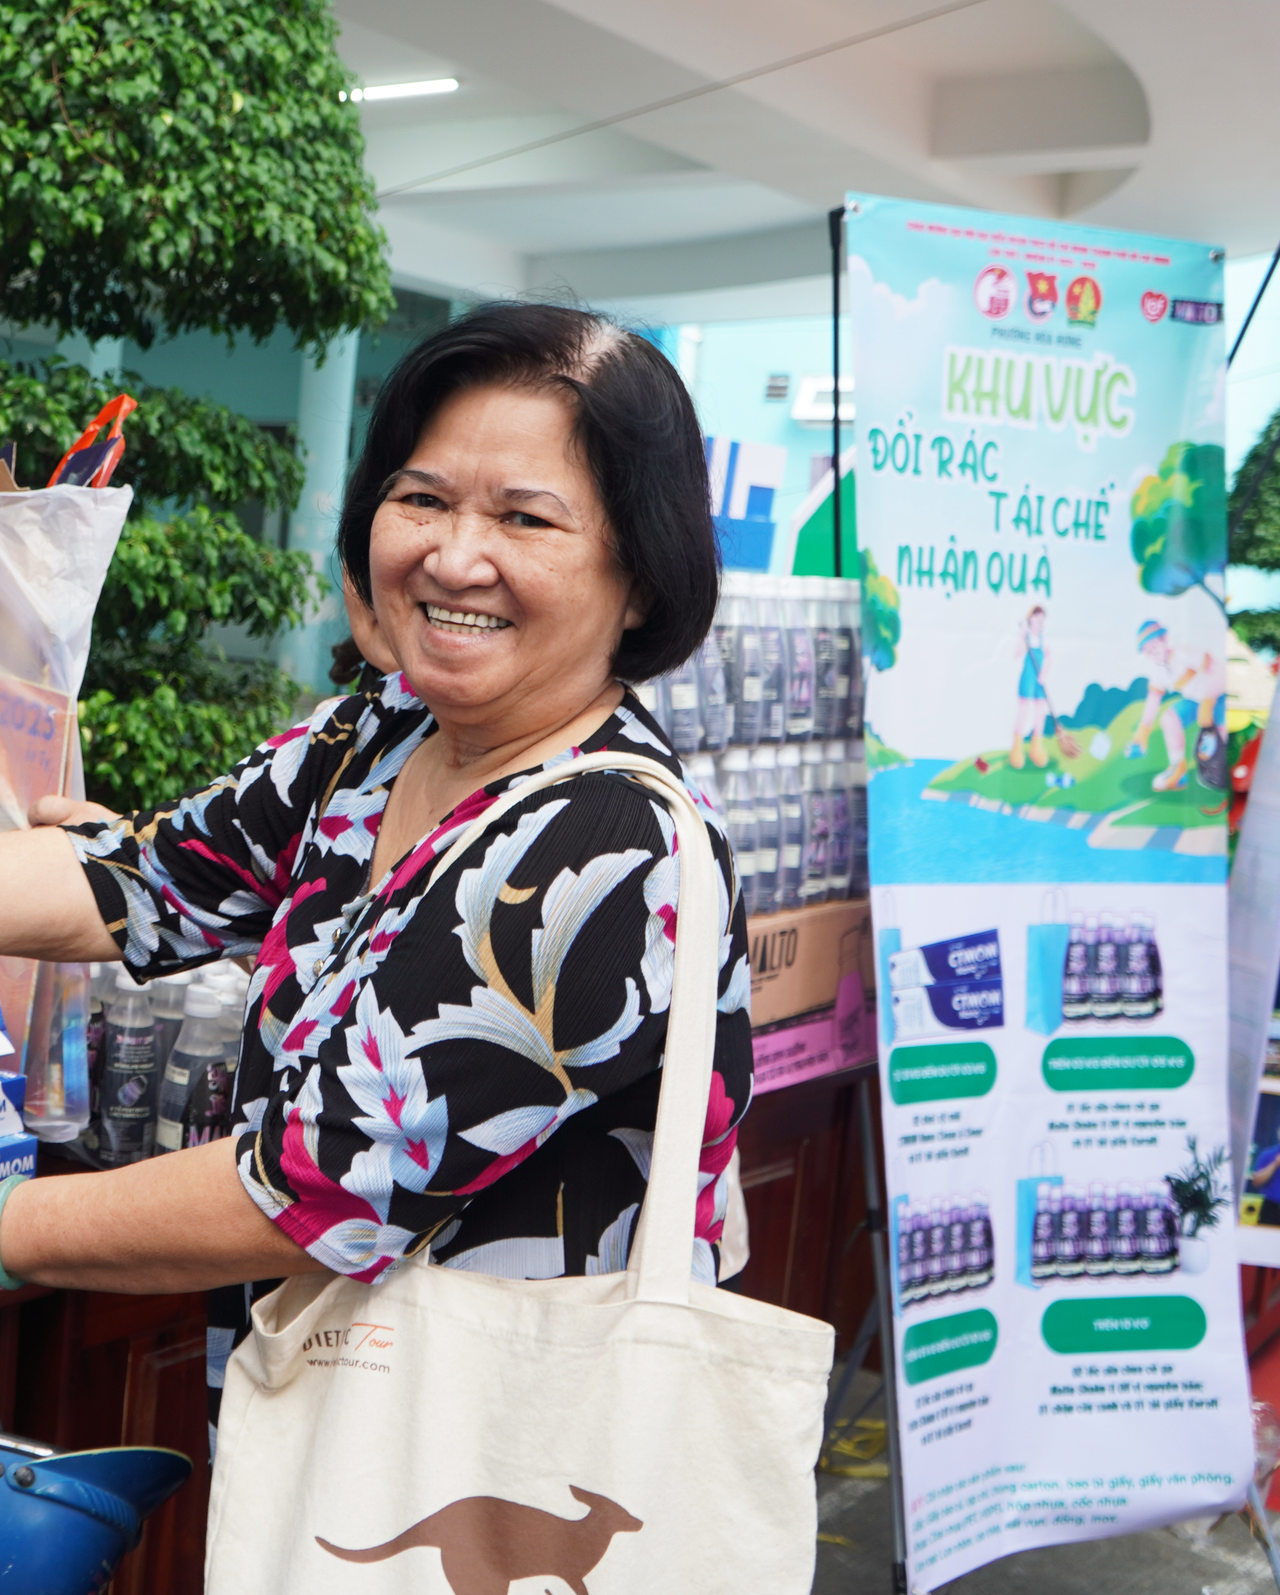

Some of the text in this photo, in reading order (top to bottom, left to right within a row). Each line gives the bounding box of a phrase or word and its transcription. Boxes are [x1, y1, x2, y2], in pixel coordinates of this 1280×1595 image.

[946, 352, 1131, 443] KHU VỰC
[931, 428, 998, 483] RÁC
[988, 484, 1043, 537] TÁI
[897, 534, 1052, 598] NHẬN QUÀ
[351, 1322, 394, 1351] Tour
